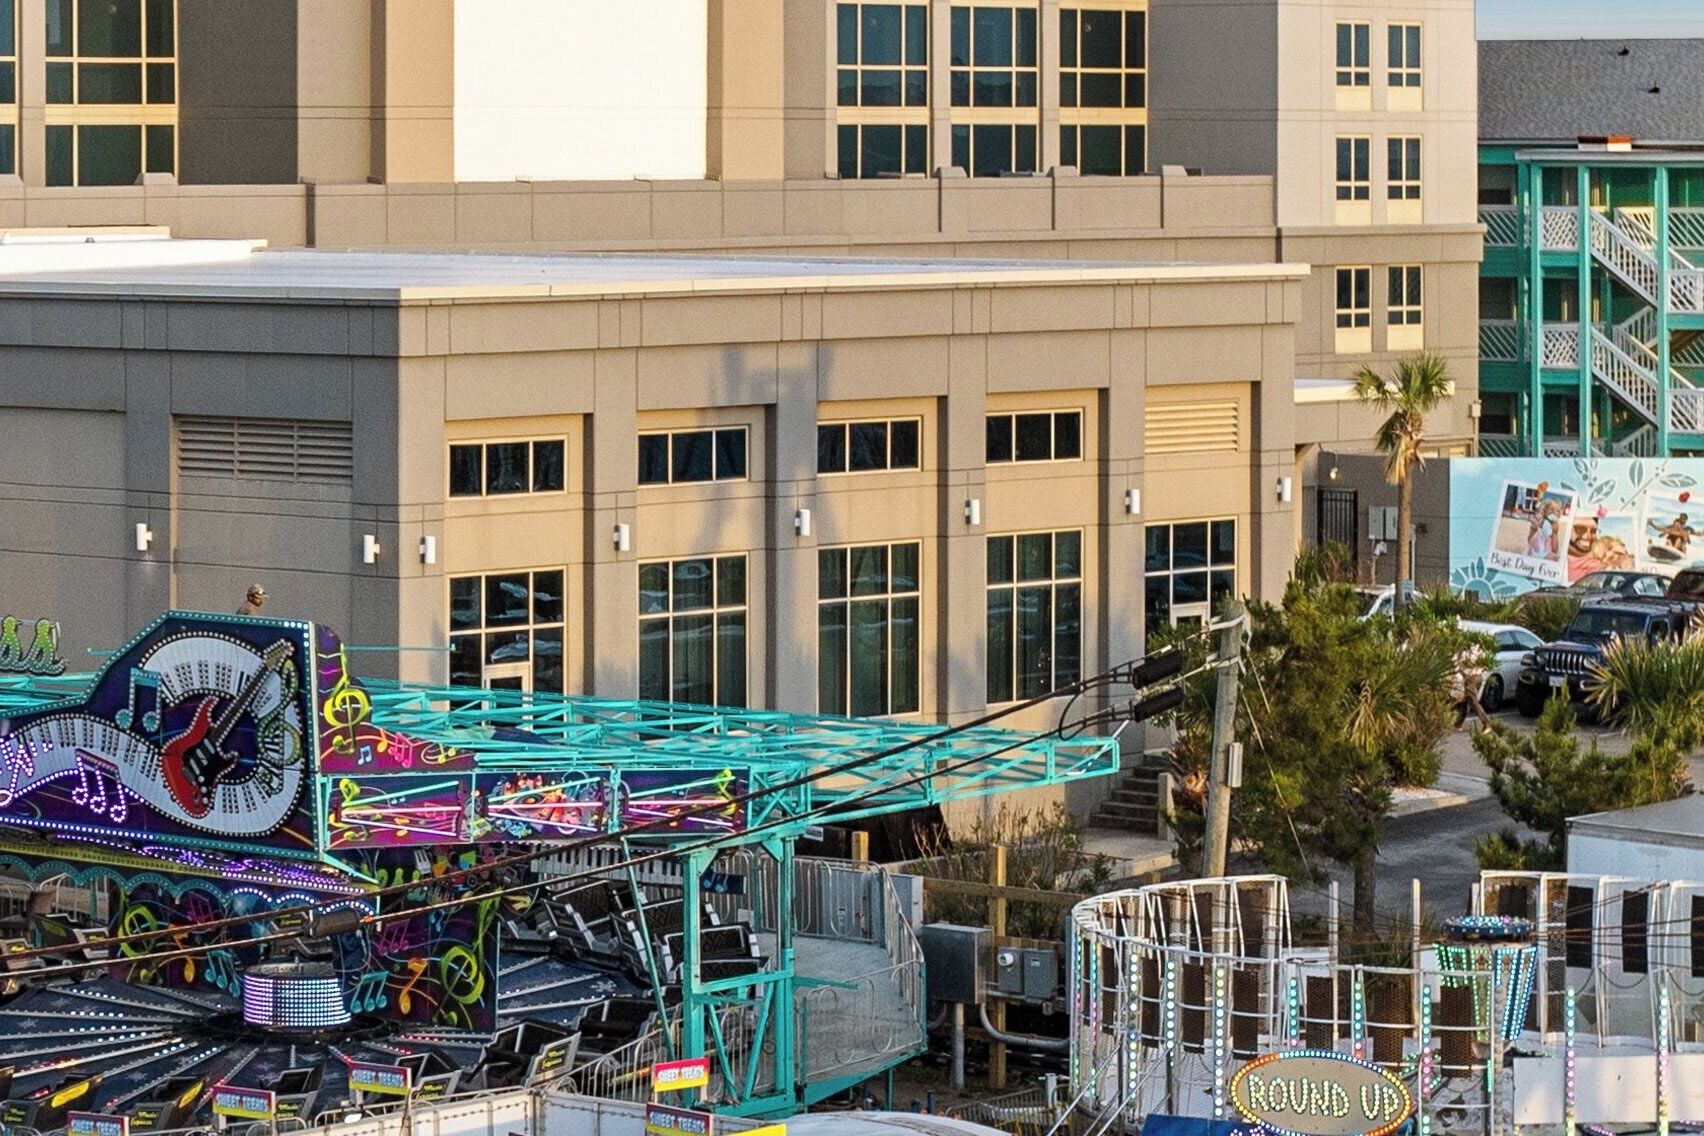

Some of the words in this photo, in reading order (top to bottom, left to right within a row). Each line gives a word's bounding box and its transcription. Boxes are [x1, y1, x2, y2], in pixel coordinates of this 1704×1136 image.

[1490, 552, 1512, 568] Best
[1514, 559, 1535, 574] Day
[1538, 564, 1560, 578] Ever
[351, 1066, 376, 1083] SWEET
[378, 1069, 405, 1088] TREATS
[657, 1068, 679, 1083] SWEET
[681, 1065, 705, 1080] TREATS
[215, 1092, 241, 1108] SWEET
[242, 1094, 269, 1112] TREATS
[1247, 1073, 1351, 1117] ROUND
[1359, 1083, 1399, 1121] UP
[70, 1119, 95, 1135] SWEET
[97, 1120, 122, 1136] TREATS
[649, 1112, 675, 1127] SWEET
[678, 1116, 706, 1135] TREATS
